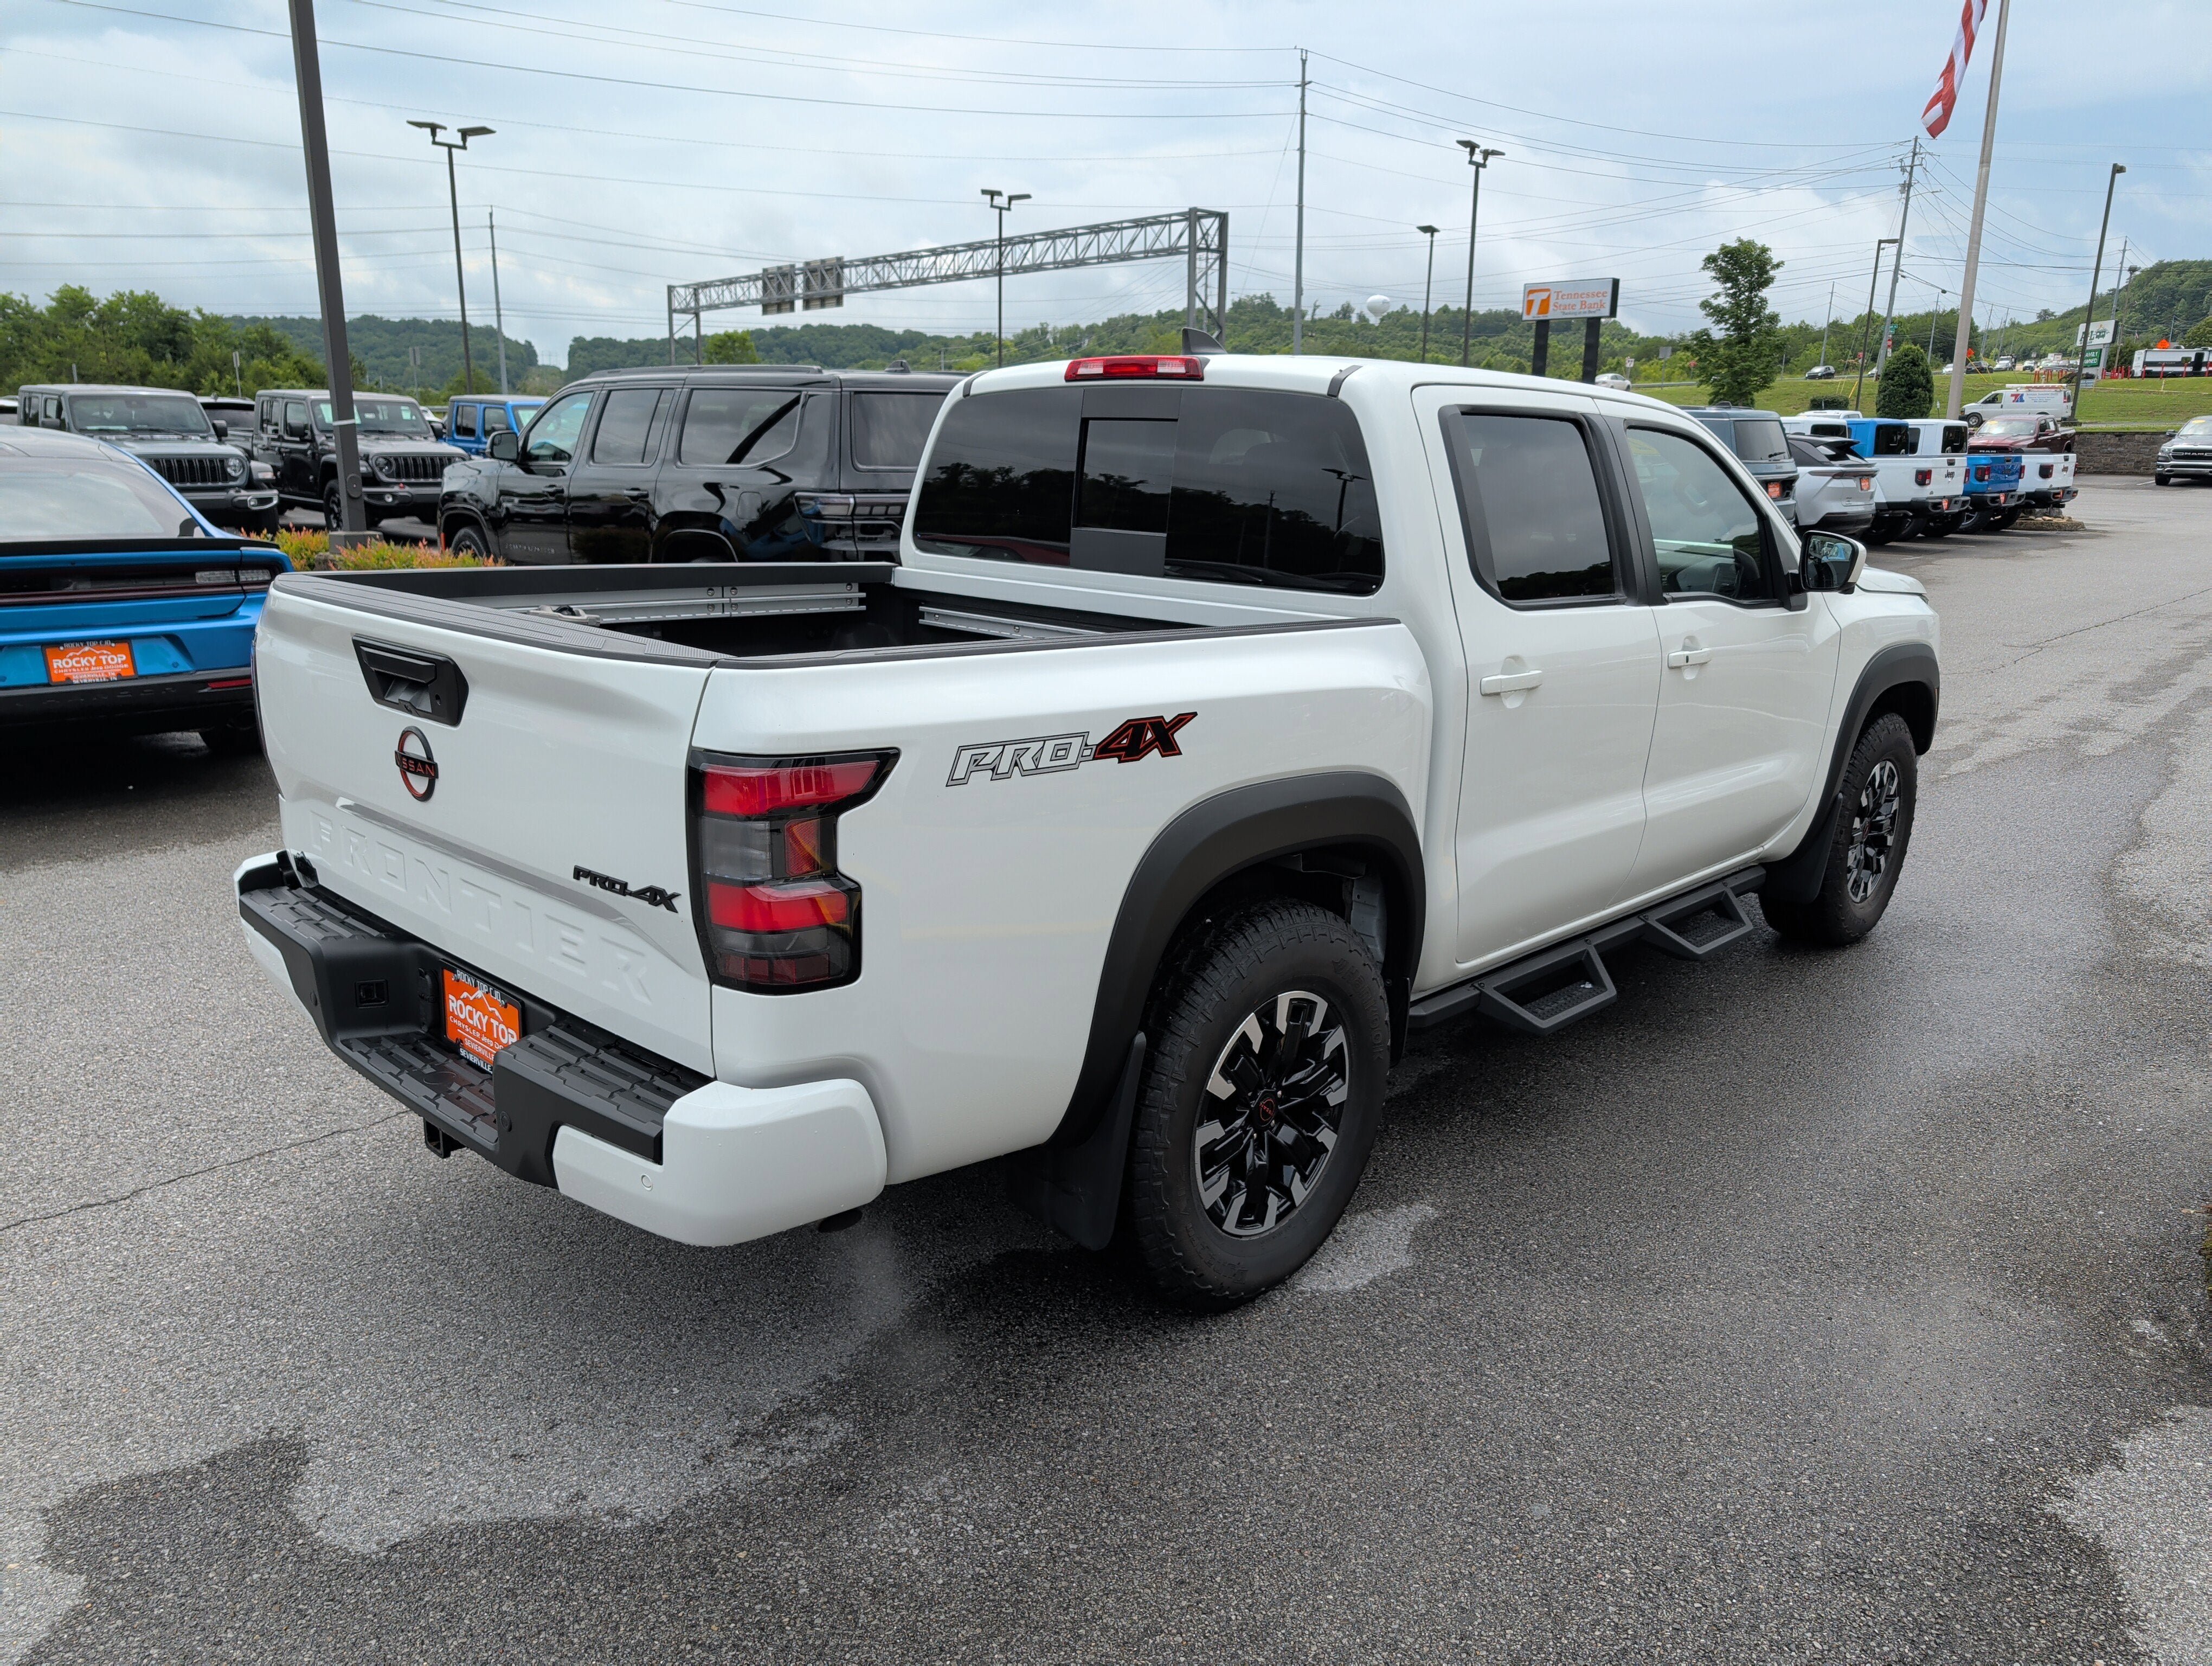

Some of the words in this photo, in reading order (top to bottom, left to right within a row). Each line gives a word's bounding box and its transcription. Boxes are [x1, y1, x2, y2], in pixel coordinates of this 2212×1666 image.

[1553, 290, 1608, 300] Tennessee
[1553, 302, 1577, 311] State
[1579, 299, 1606, 310] Bank
[1945, 470, 1955, 479] Jeep
[53, 656, 97, 669] ROCKY
[99, 654, 126, 665] TOP
[946, 712, 1198, 787] PRO-4X
[573, 865, 681, 913] PRO-4X
[311, 810, 653, 1005] FRONTIER
[456, 969, 475, 988] ROCKY
[477, 981, 488, 994] TOP
[490, 988, 501, 1002] CJD
[448, 994, 488, 1033] ROCKY
[490, 1017, 517, 1045] TOP
[449, 1015, 480, 1039] CHRYSLER
[481, 1033, 493, 1047] Jeep
